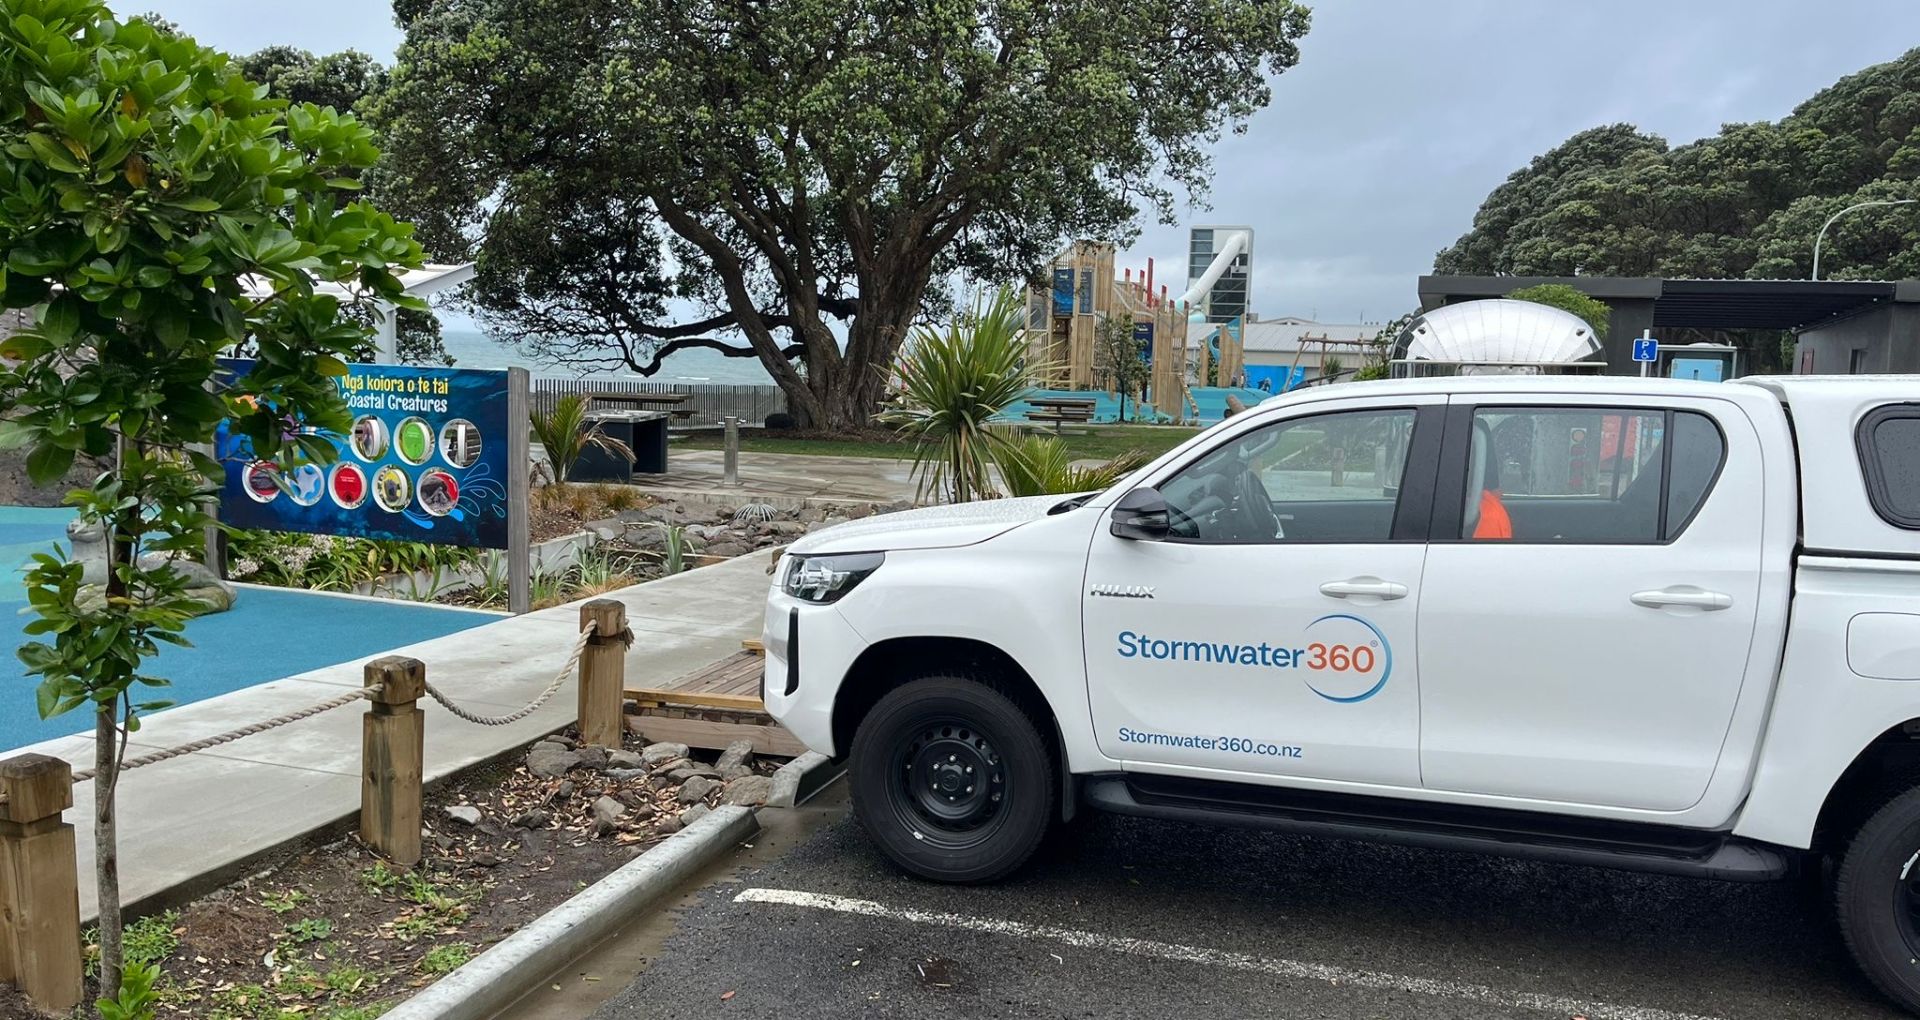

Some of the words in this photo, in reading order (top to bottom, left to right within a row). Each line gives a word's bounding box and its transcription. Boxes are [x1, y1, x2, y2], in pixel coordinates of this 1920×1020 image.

[1642, 341, 1650, 349] P
[366, 374, 404, 393] koiora
[407, 380, 415, 393] o
[418, 377, 430, 393] te
[432, 377, 449, 395] tai
[387, 394, 448, 413] Creatures
[1090, 583, 1157, 599] HILUX
[1118, 727, 1303, 759] Stormwater360.co.nz
